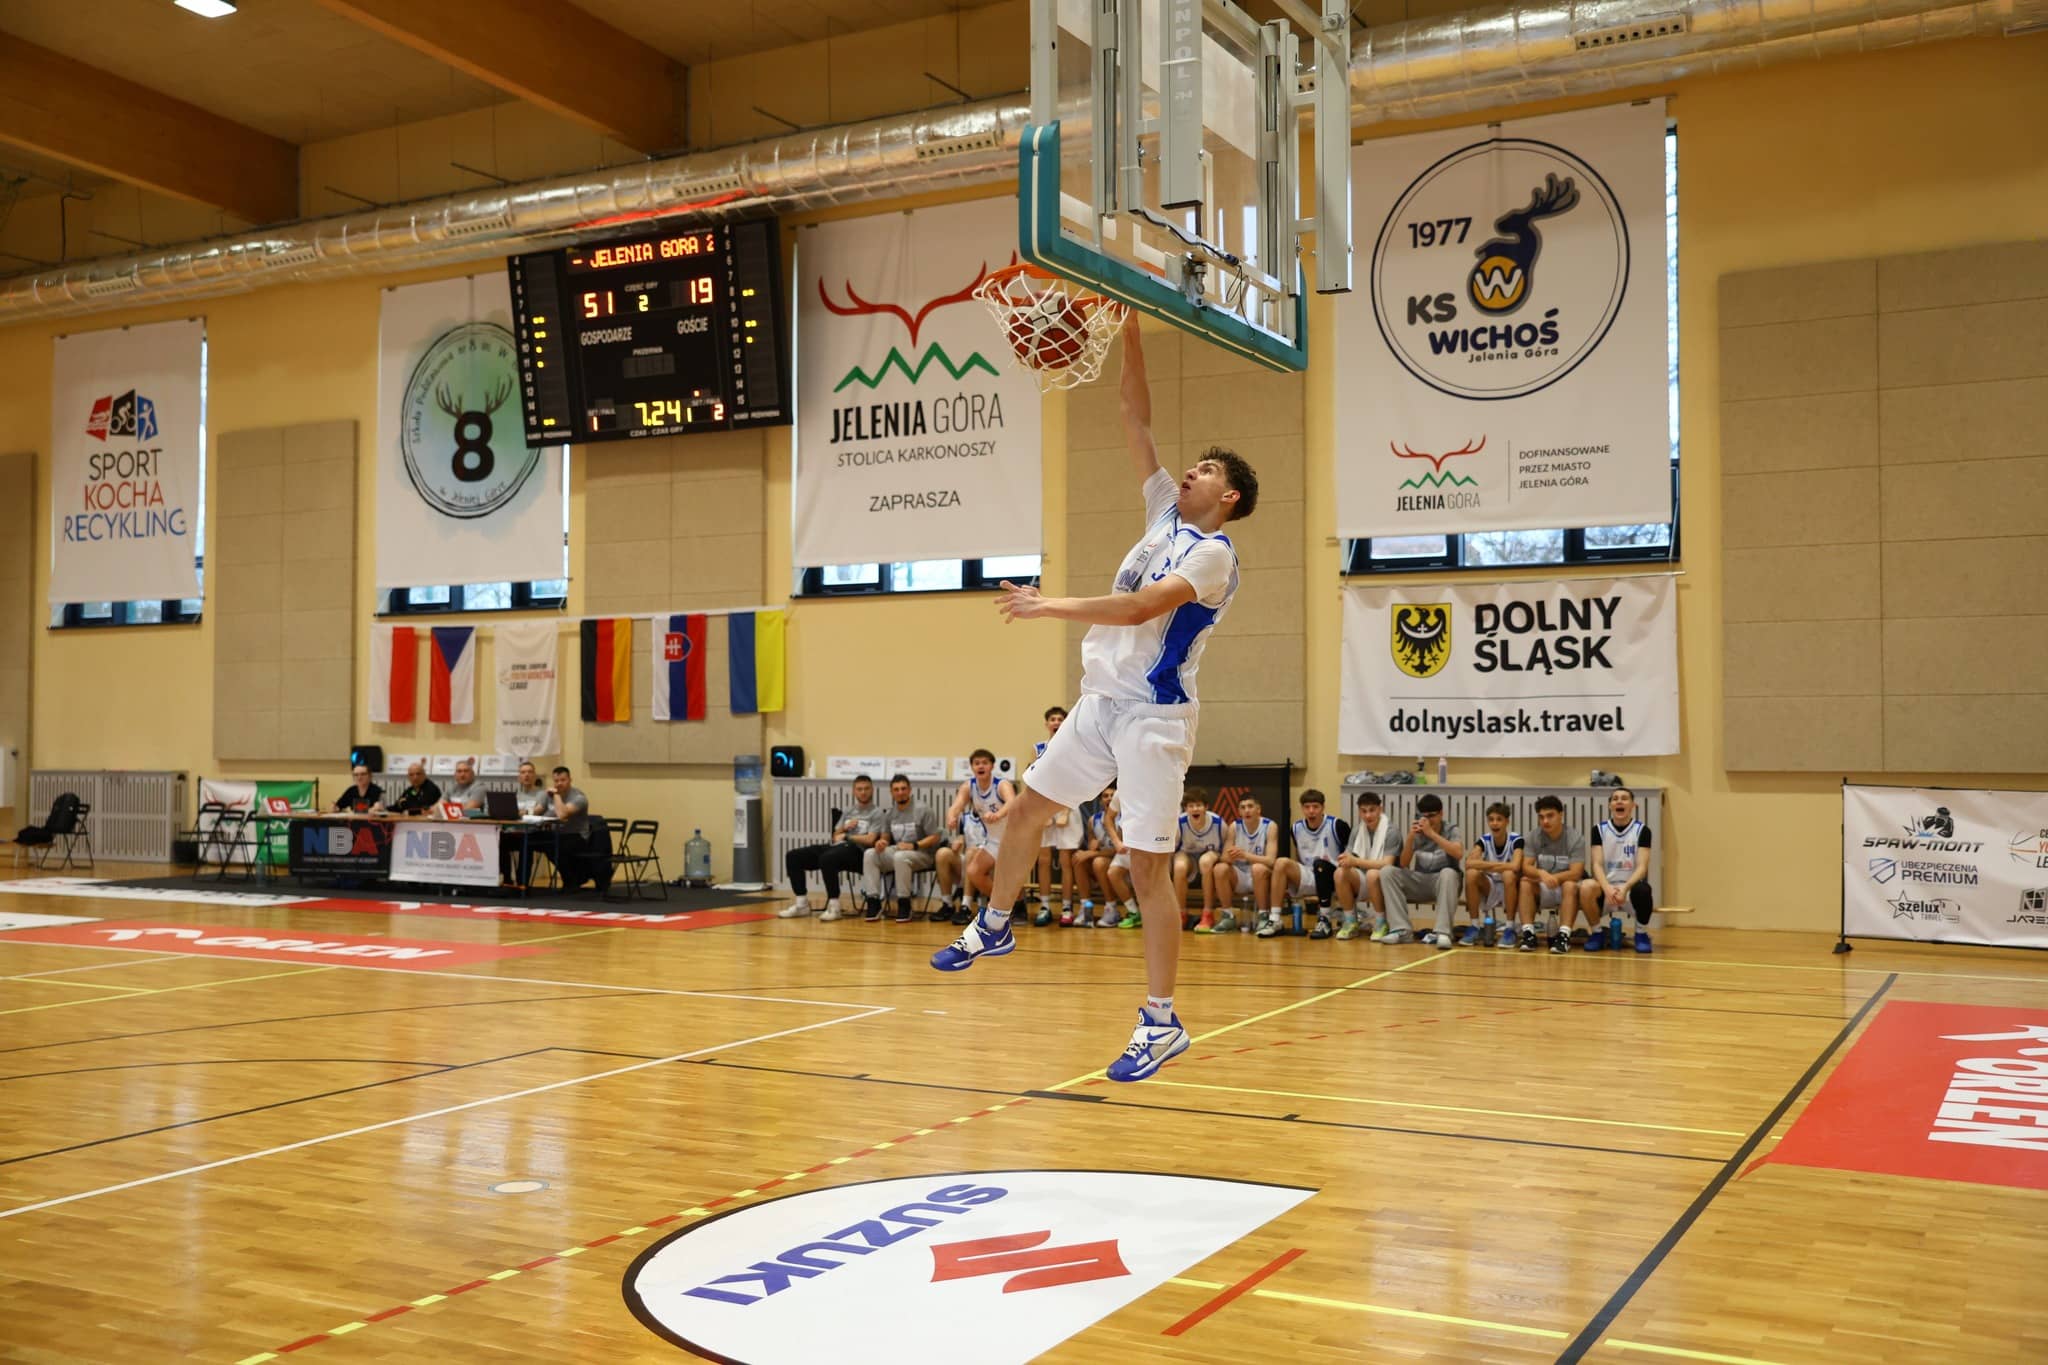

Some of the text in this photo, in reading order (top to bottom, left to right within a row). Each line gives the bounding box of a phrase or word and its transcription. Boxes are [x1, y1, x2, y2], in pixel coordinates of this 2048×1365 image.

[1408, 217, 1472, 249] 1977
[590, 242, 653, 268] JELENIA
[660, 236, 699, 258] GORA
[583, 291, 613, 318] 51
[638, 294, 649, 312] 2
[690, 277, 713, 305] 19
[1407, 293, 1457, 326] KS
[581, 326, 633, 346] GOSPODARZE
[677, 316, 708, 335] GOŚCIE
[1428, 308, 1560, 355] WICHOŚ
[1468, 347, 1559, 363] Jelenia Góra
[592, 416, 599, 432] 1
[713, 403, 724, 421] 2
[830, 392, 1004, 444] JELENIA GÓRA
[452, 410, 495, 482] 8
[837, 440, 997, 467] STOLICA KARKONOSZY
[1519, 444, 1610, 460] DOFINANSOWANE
[89, 448, 164, 481] SPORT
[1519, 461, 1591, 474] PRZEZ MIASTO
[84, 480, 164, 511] KOCHA
[1519, 475, 1589, 489] JELENIA GÓRA
[869, 490, 961, 513] ZAPRASZA
[1396, 492, 1481, 512] JELENIA GÓRA
[63, 507, 187, 543] RECYKLING
[1474, 596, 1622, 635] DOLNY
[1472, 631, 1613, 675] ŚLĄSK
[1389, 706, 1625, 740] dolnyslask.travel
[303, 826, 379, 856] NBA
[405, 830, 484, 862] NBA
[1900, 860, 1978, 873] UBEZPIECZENIA
[1901, 869, 1979, 885] PREMIUM
[1898, 900, 1940, 914] szelux
[194, 936, 453, 960] ORLEN
[680, 1183, 1008, 1306] SUZUKI
